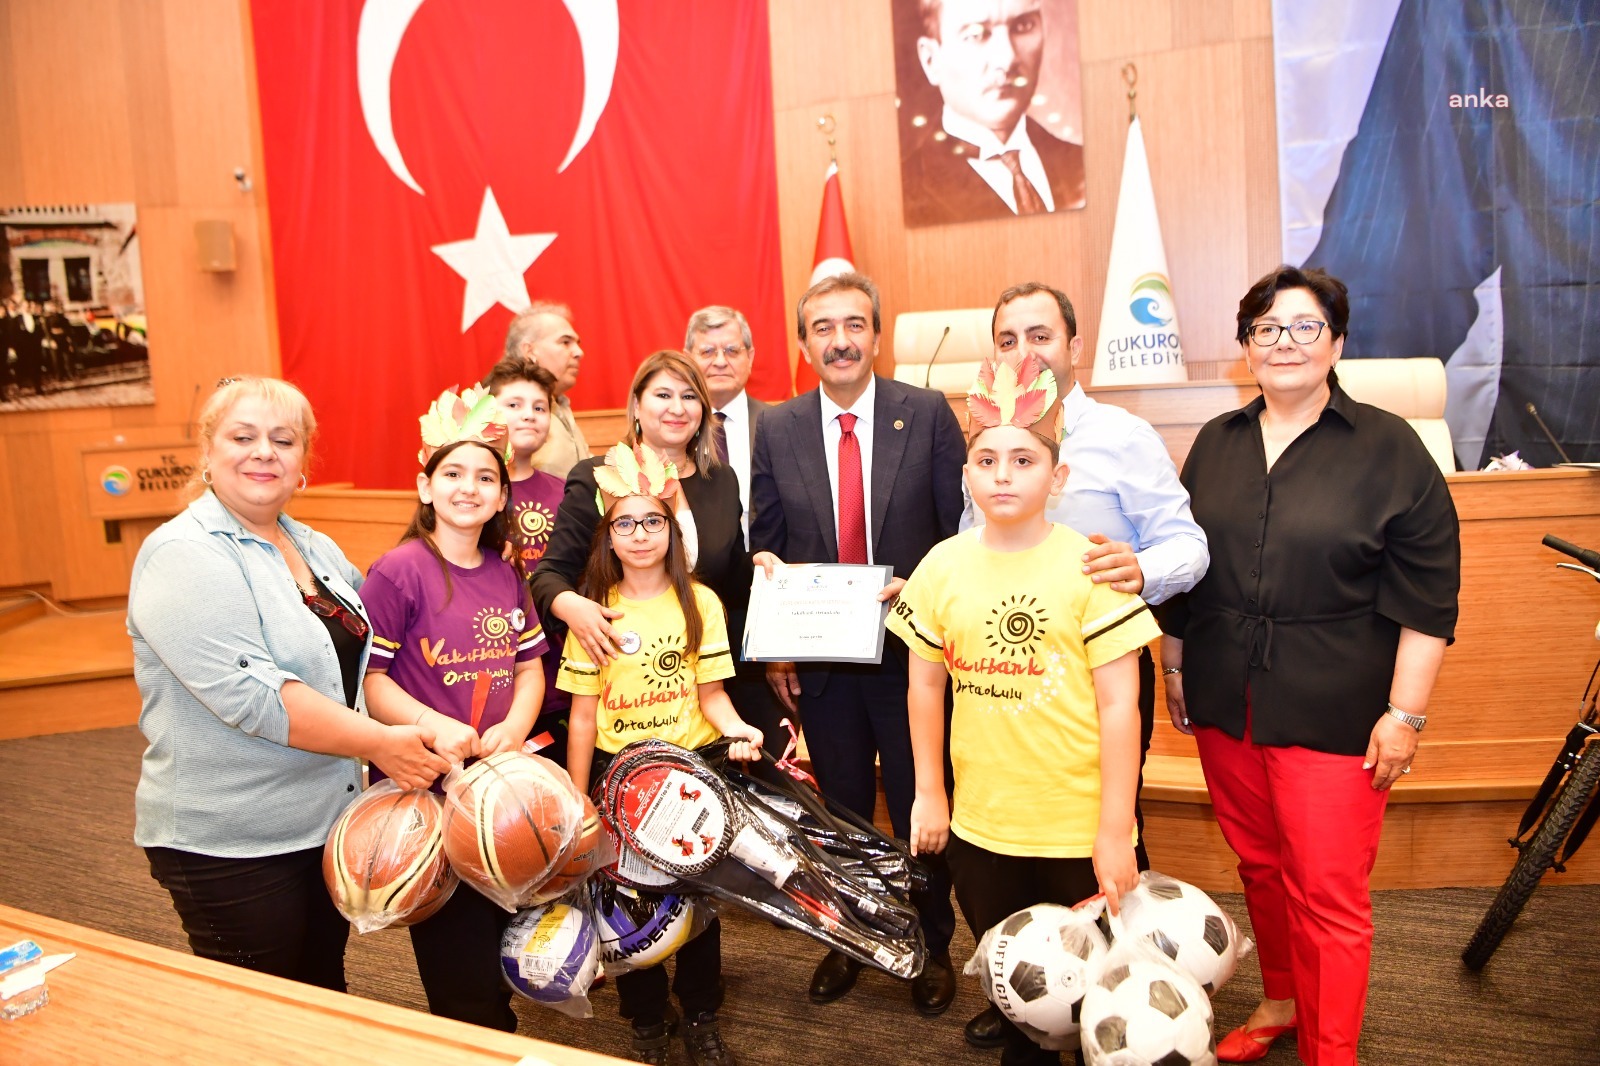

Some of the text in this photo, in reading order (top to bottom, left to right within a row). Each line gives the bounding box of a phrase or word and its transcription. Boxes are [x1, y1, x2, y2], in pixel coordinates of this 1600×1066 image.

[1107, 333, 1180, 357] ÇUKURO
[137, 465, 194, 481] ÇUKURO
[443, 668, 509, 686] Ortakulu
[614, 715, 679, 733] Ortaokulu
[600, 895, 686, 965] WANDERE
[994, 940, 1017, 1019] OFFICIAL
